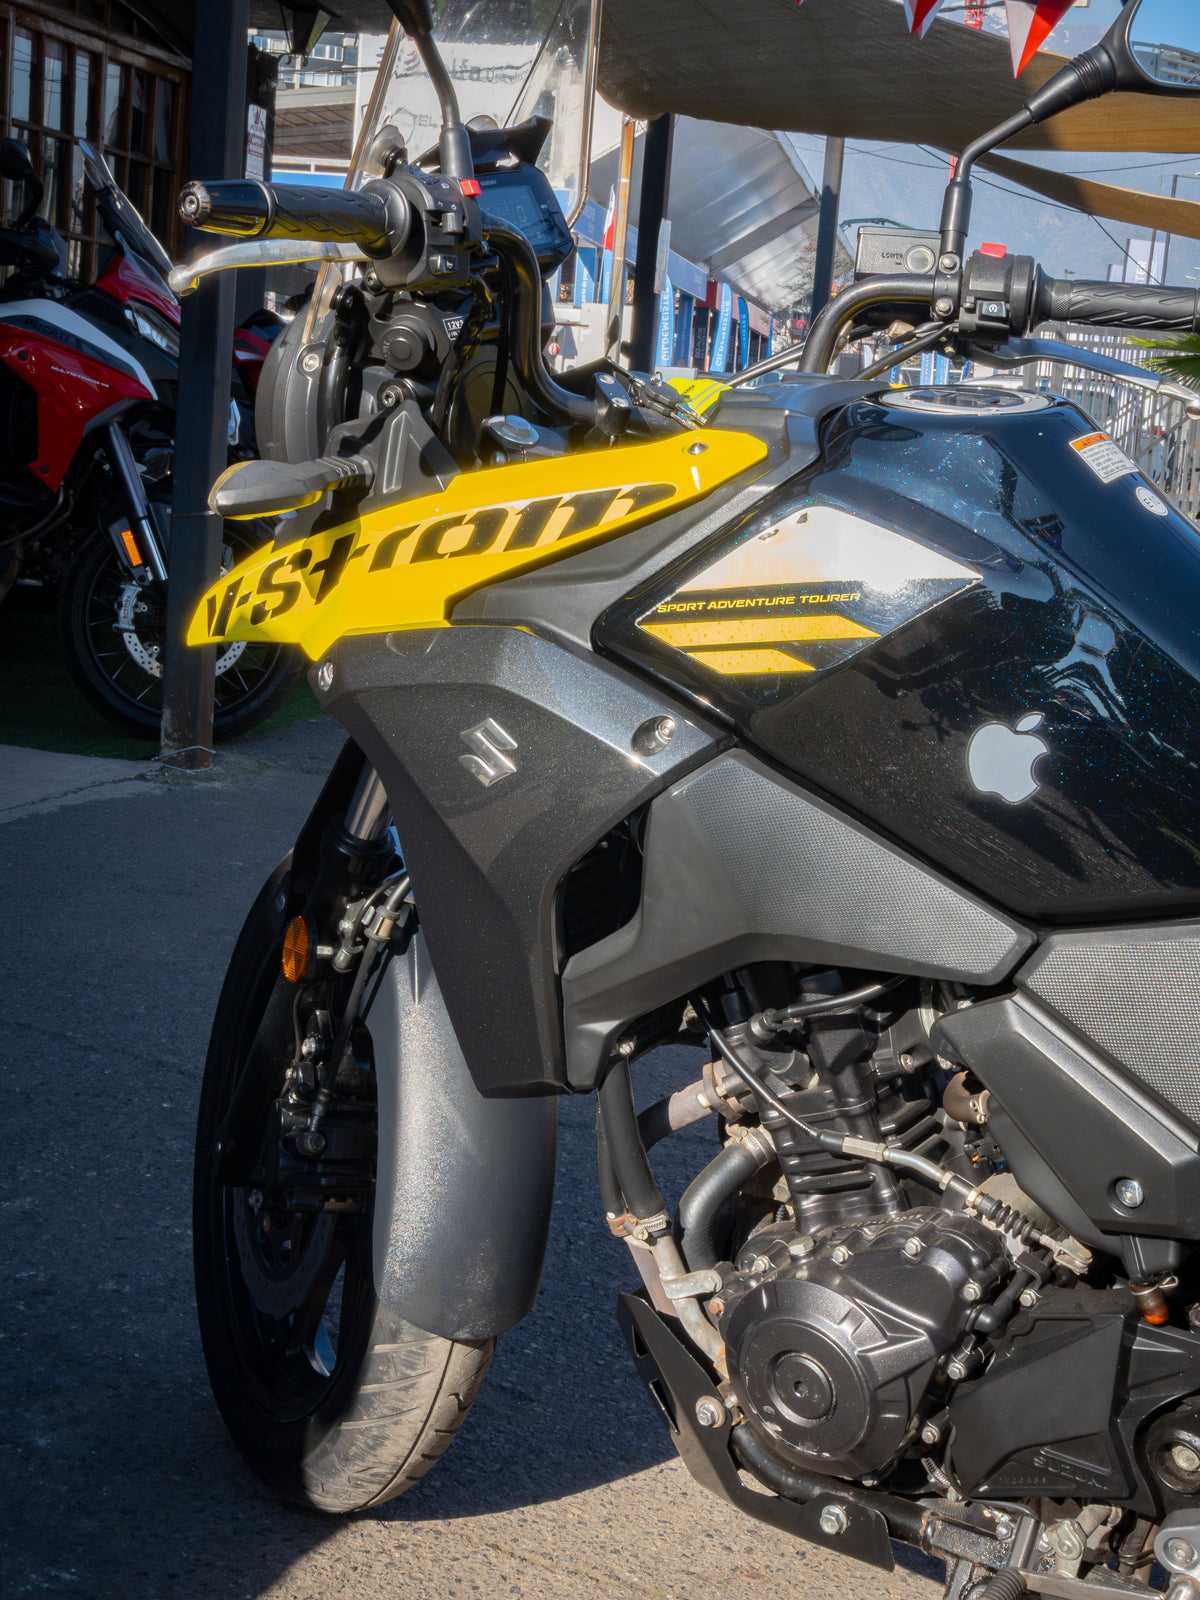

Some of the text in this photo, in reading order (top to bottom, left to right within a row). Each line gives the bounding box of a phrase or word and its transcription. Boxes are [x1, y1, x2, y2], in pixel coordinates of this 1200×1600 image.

[207, 483, 677, 637] V-Strom
[657, 592, 861, 613] SPORT ADVENTURE TOURER
